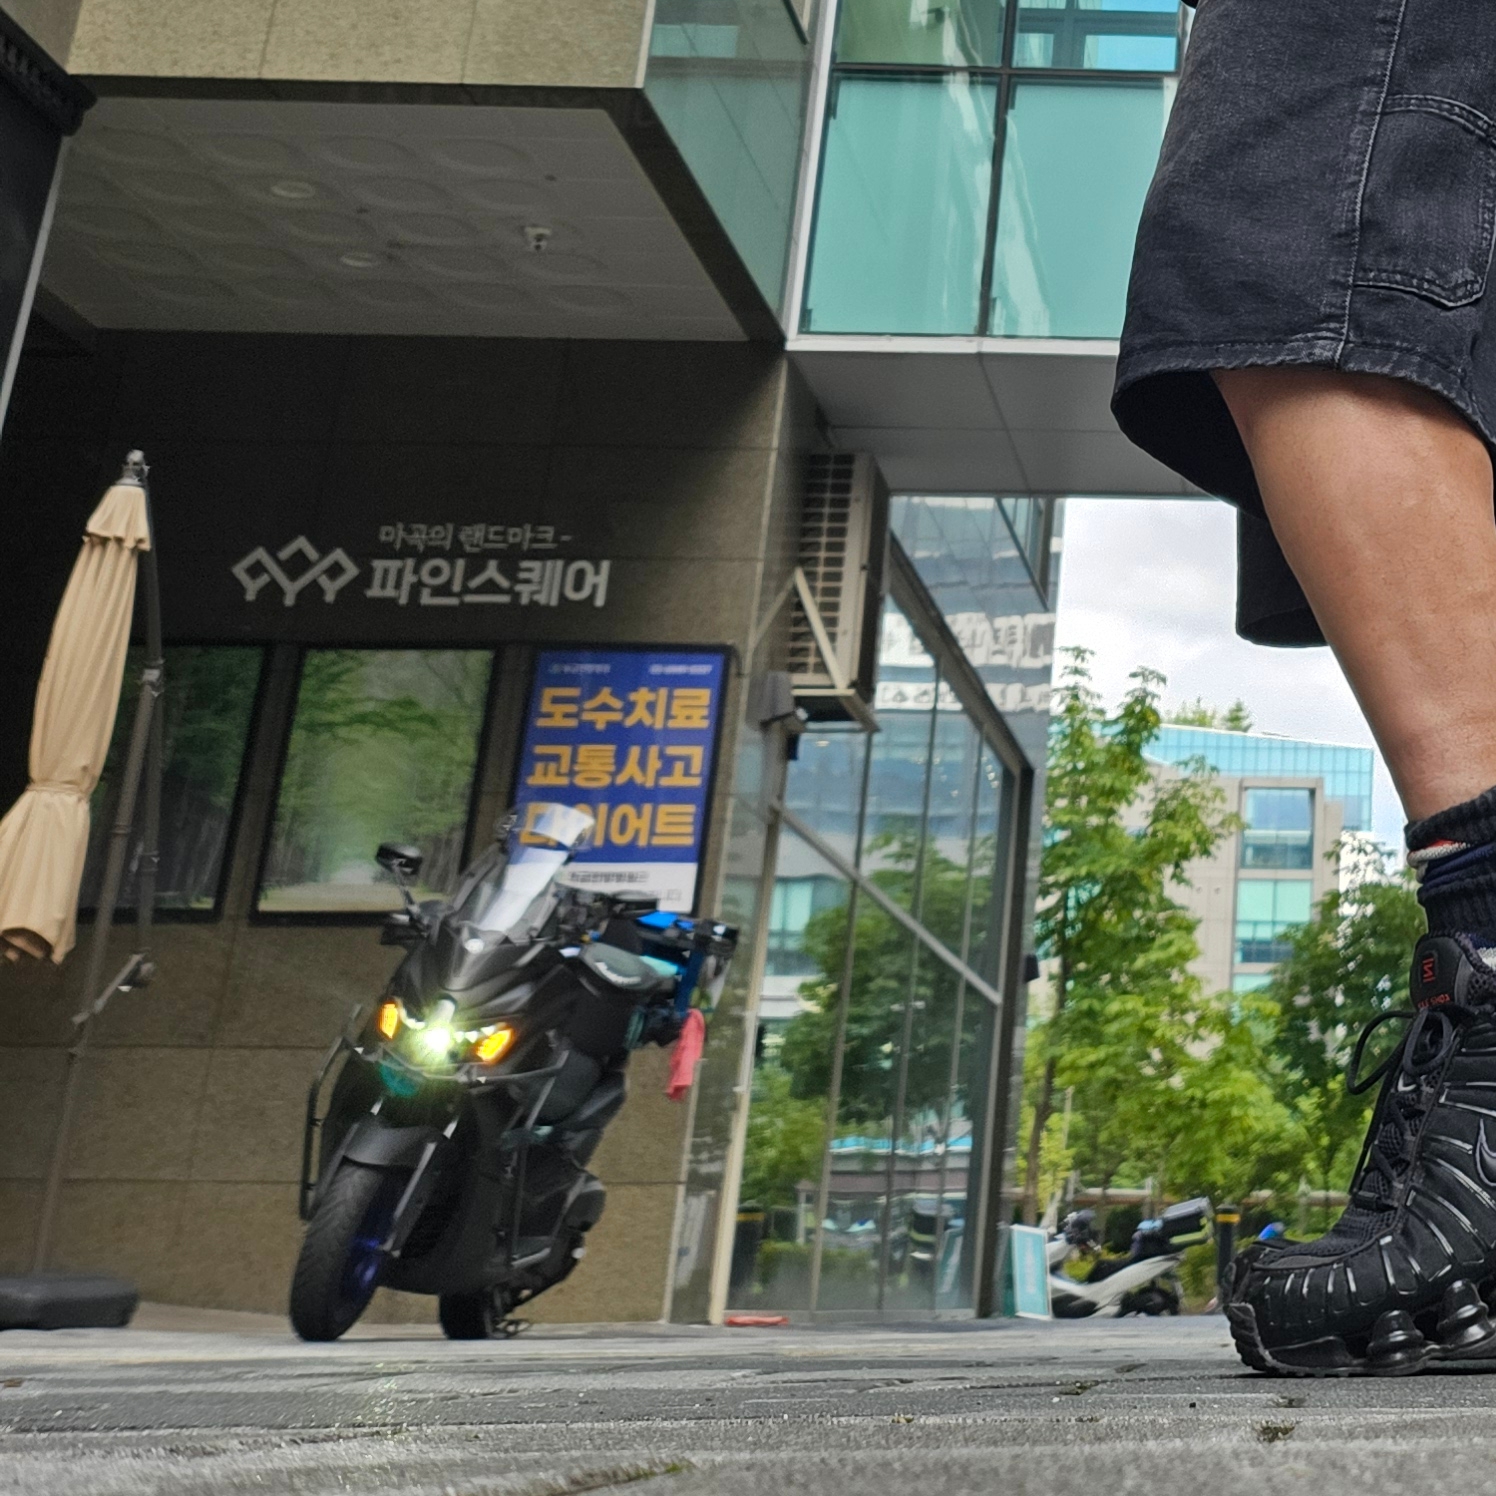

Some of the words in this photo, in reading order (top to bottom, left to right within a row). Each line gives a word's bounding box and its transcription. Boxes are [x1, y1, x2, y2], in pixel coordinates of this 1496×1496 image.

[378, 521, 454, 552] 마곡의
[364, 557, 612, 608] 파인스퀘어
[535, 686, 712, 731] 도수치료
[525, 743, 705, 790] 교통사고
